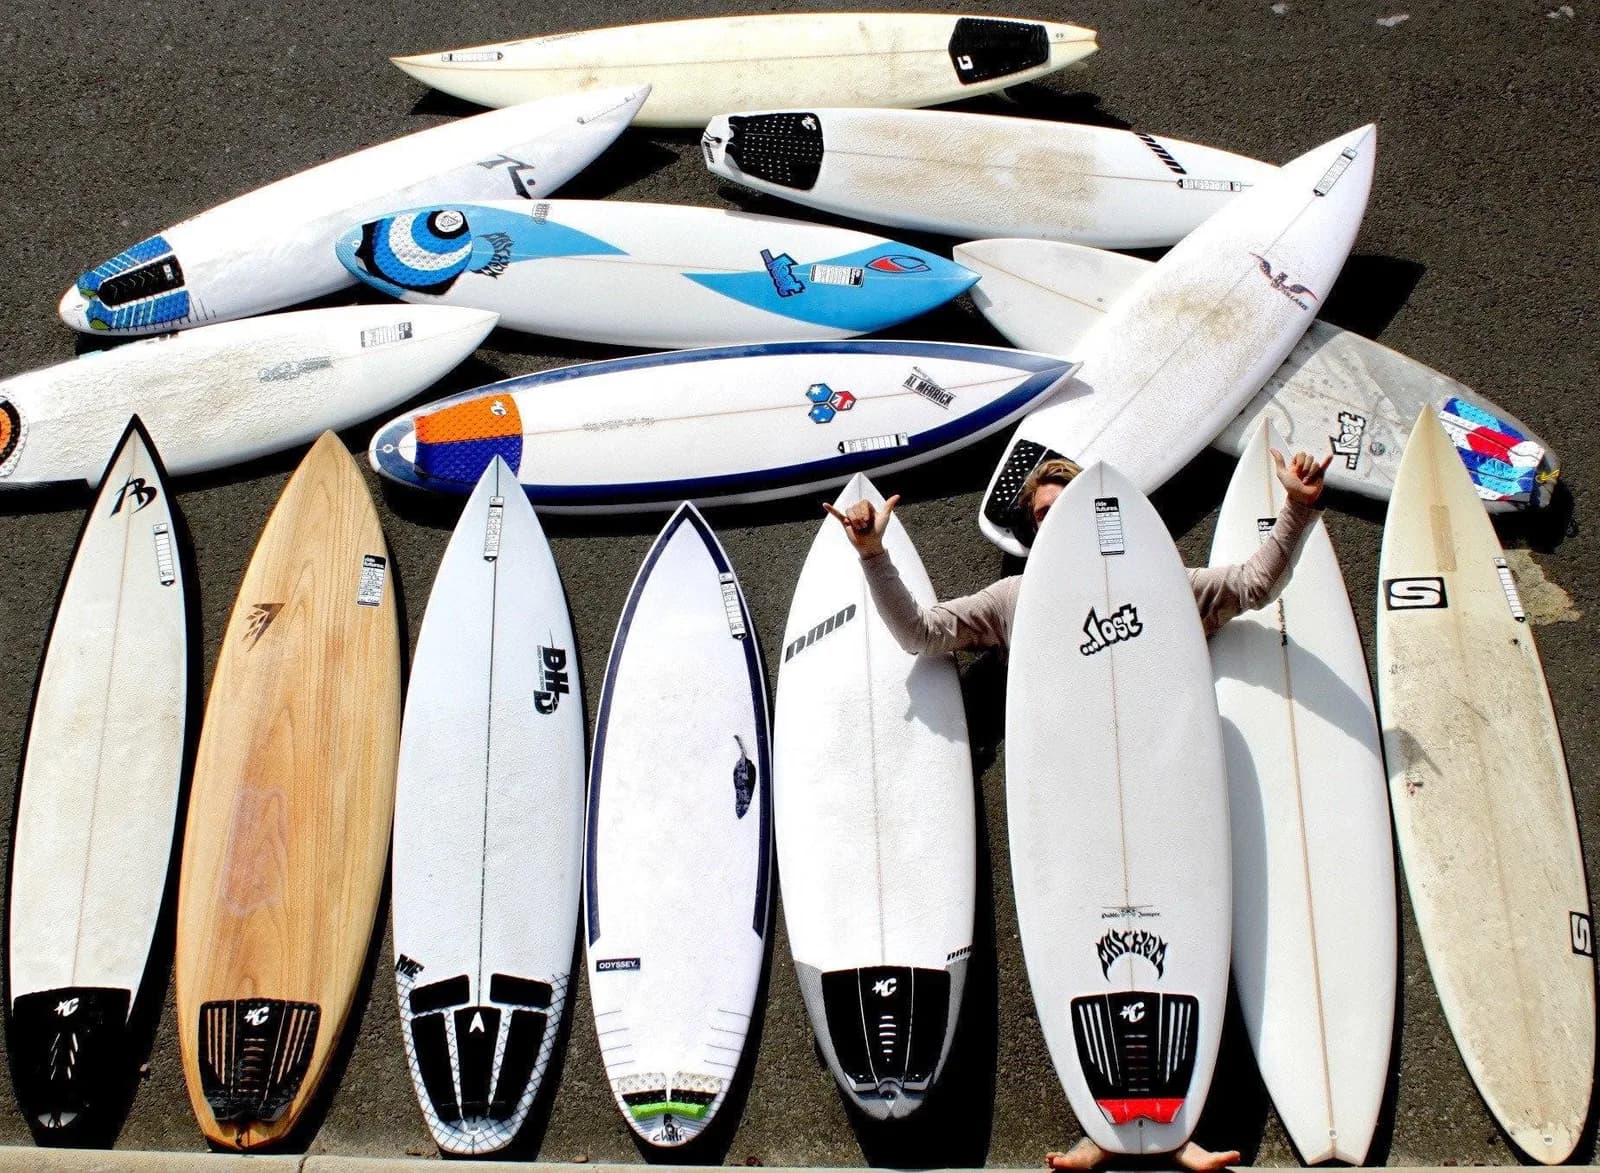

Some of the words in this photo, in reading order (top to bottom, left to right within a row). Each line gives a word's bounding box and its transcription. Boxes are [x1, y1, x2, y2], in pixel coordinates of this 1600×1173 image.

[904, 375, 917, 388] AL
[915, 381, 955, 407] MERRICK
[533, 645, 570, 715] DHD
[598, 960, 637, 969] ODYSSEY
[1095, 927, 1169, 982] MAYHEM
